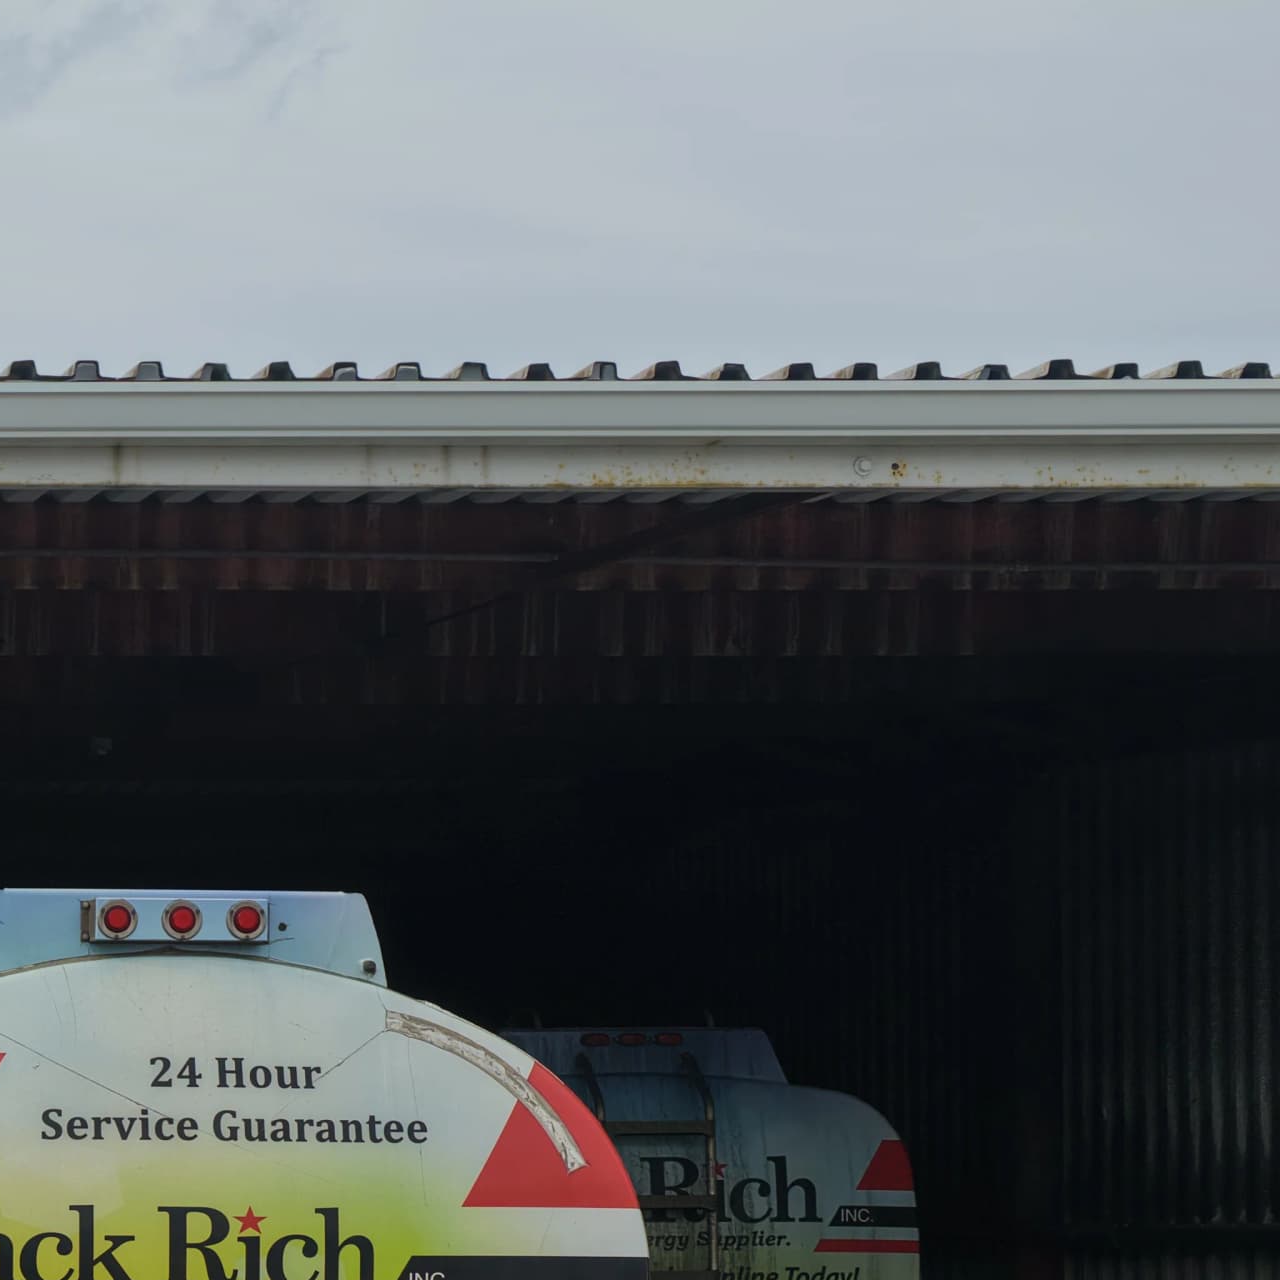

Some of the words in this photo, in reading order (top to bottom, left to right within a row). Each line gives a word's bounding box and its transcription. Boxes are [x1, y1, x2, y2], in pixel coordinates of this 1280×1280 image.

[149, 1056, 202, 1088] 24
[215, 1057, 322, 1089] Hour
[40, 1108, 199, 1141] Service
[212, 1109, 429, 1143] Guarantee
[639, 1156, 823, 1223] Rich
[840, 1207, 874, 1222] INC.
[696, 1231, 791, 1250] Spplier.
